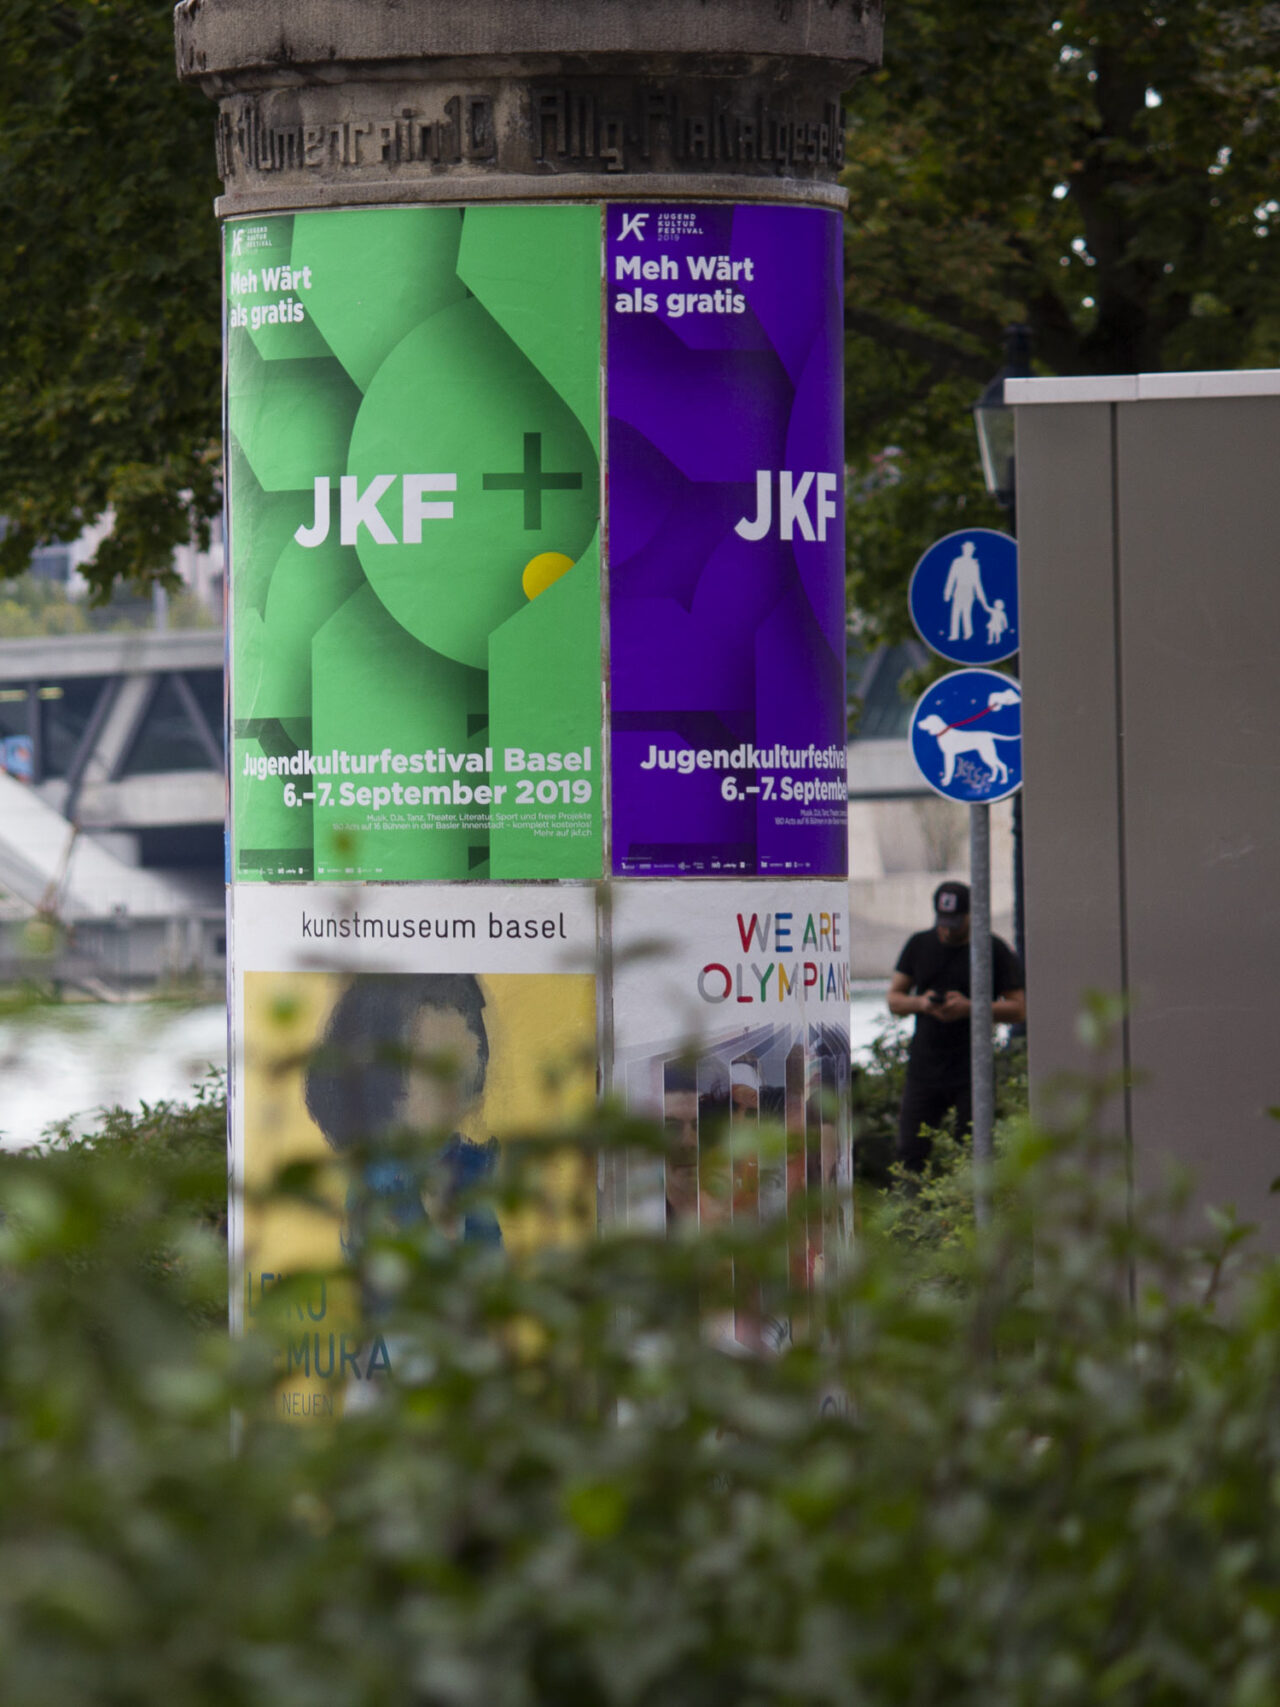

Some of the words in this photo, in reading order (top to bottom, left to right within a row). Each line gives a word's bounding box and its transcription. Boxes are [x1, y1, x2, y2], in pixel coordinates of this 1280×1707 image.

[657, 227, 705, 235] FESTIVAL
[230, 268, 258, 296] Meh
[261, 265, 312, 293] Wärt
[615, 256, 679, 282] Meh
[686, 255, 754, 282] Wärt
[230, 303, 248, 328] als
[251, 297, 305, 330] gratis
[615, 288, 658, 313] als
[666, 288, 746, 318] gratis
[294, 473, 457, 548] JKF
[734, 470, 837, 541] JKF
[243, 748, 493, 780] Jugendkulturfestival
[504, 747, 592, 773] Basel
[339, 779, 507, 811] September
[515, 779, 592, 804] 2019
[495, 812, 517, 823] Sport
[558, 812, 592, 822] Projekte
[513, 821, 549, 831] komplett
[534, 829, 553, 837] Mehr
[302, 911, 476, 939] kunstmuseum
[488, 912, 567, 939] basel
[736, 912, 793, 953] WE
[802, 912, 841, 952] ARE
[282, 1392, 333, 1416] NEUEN
